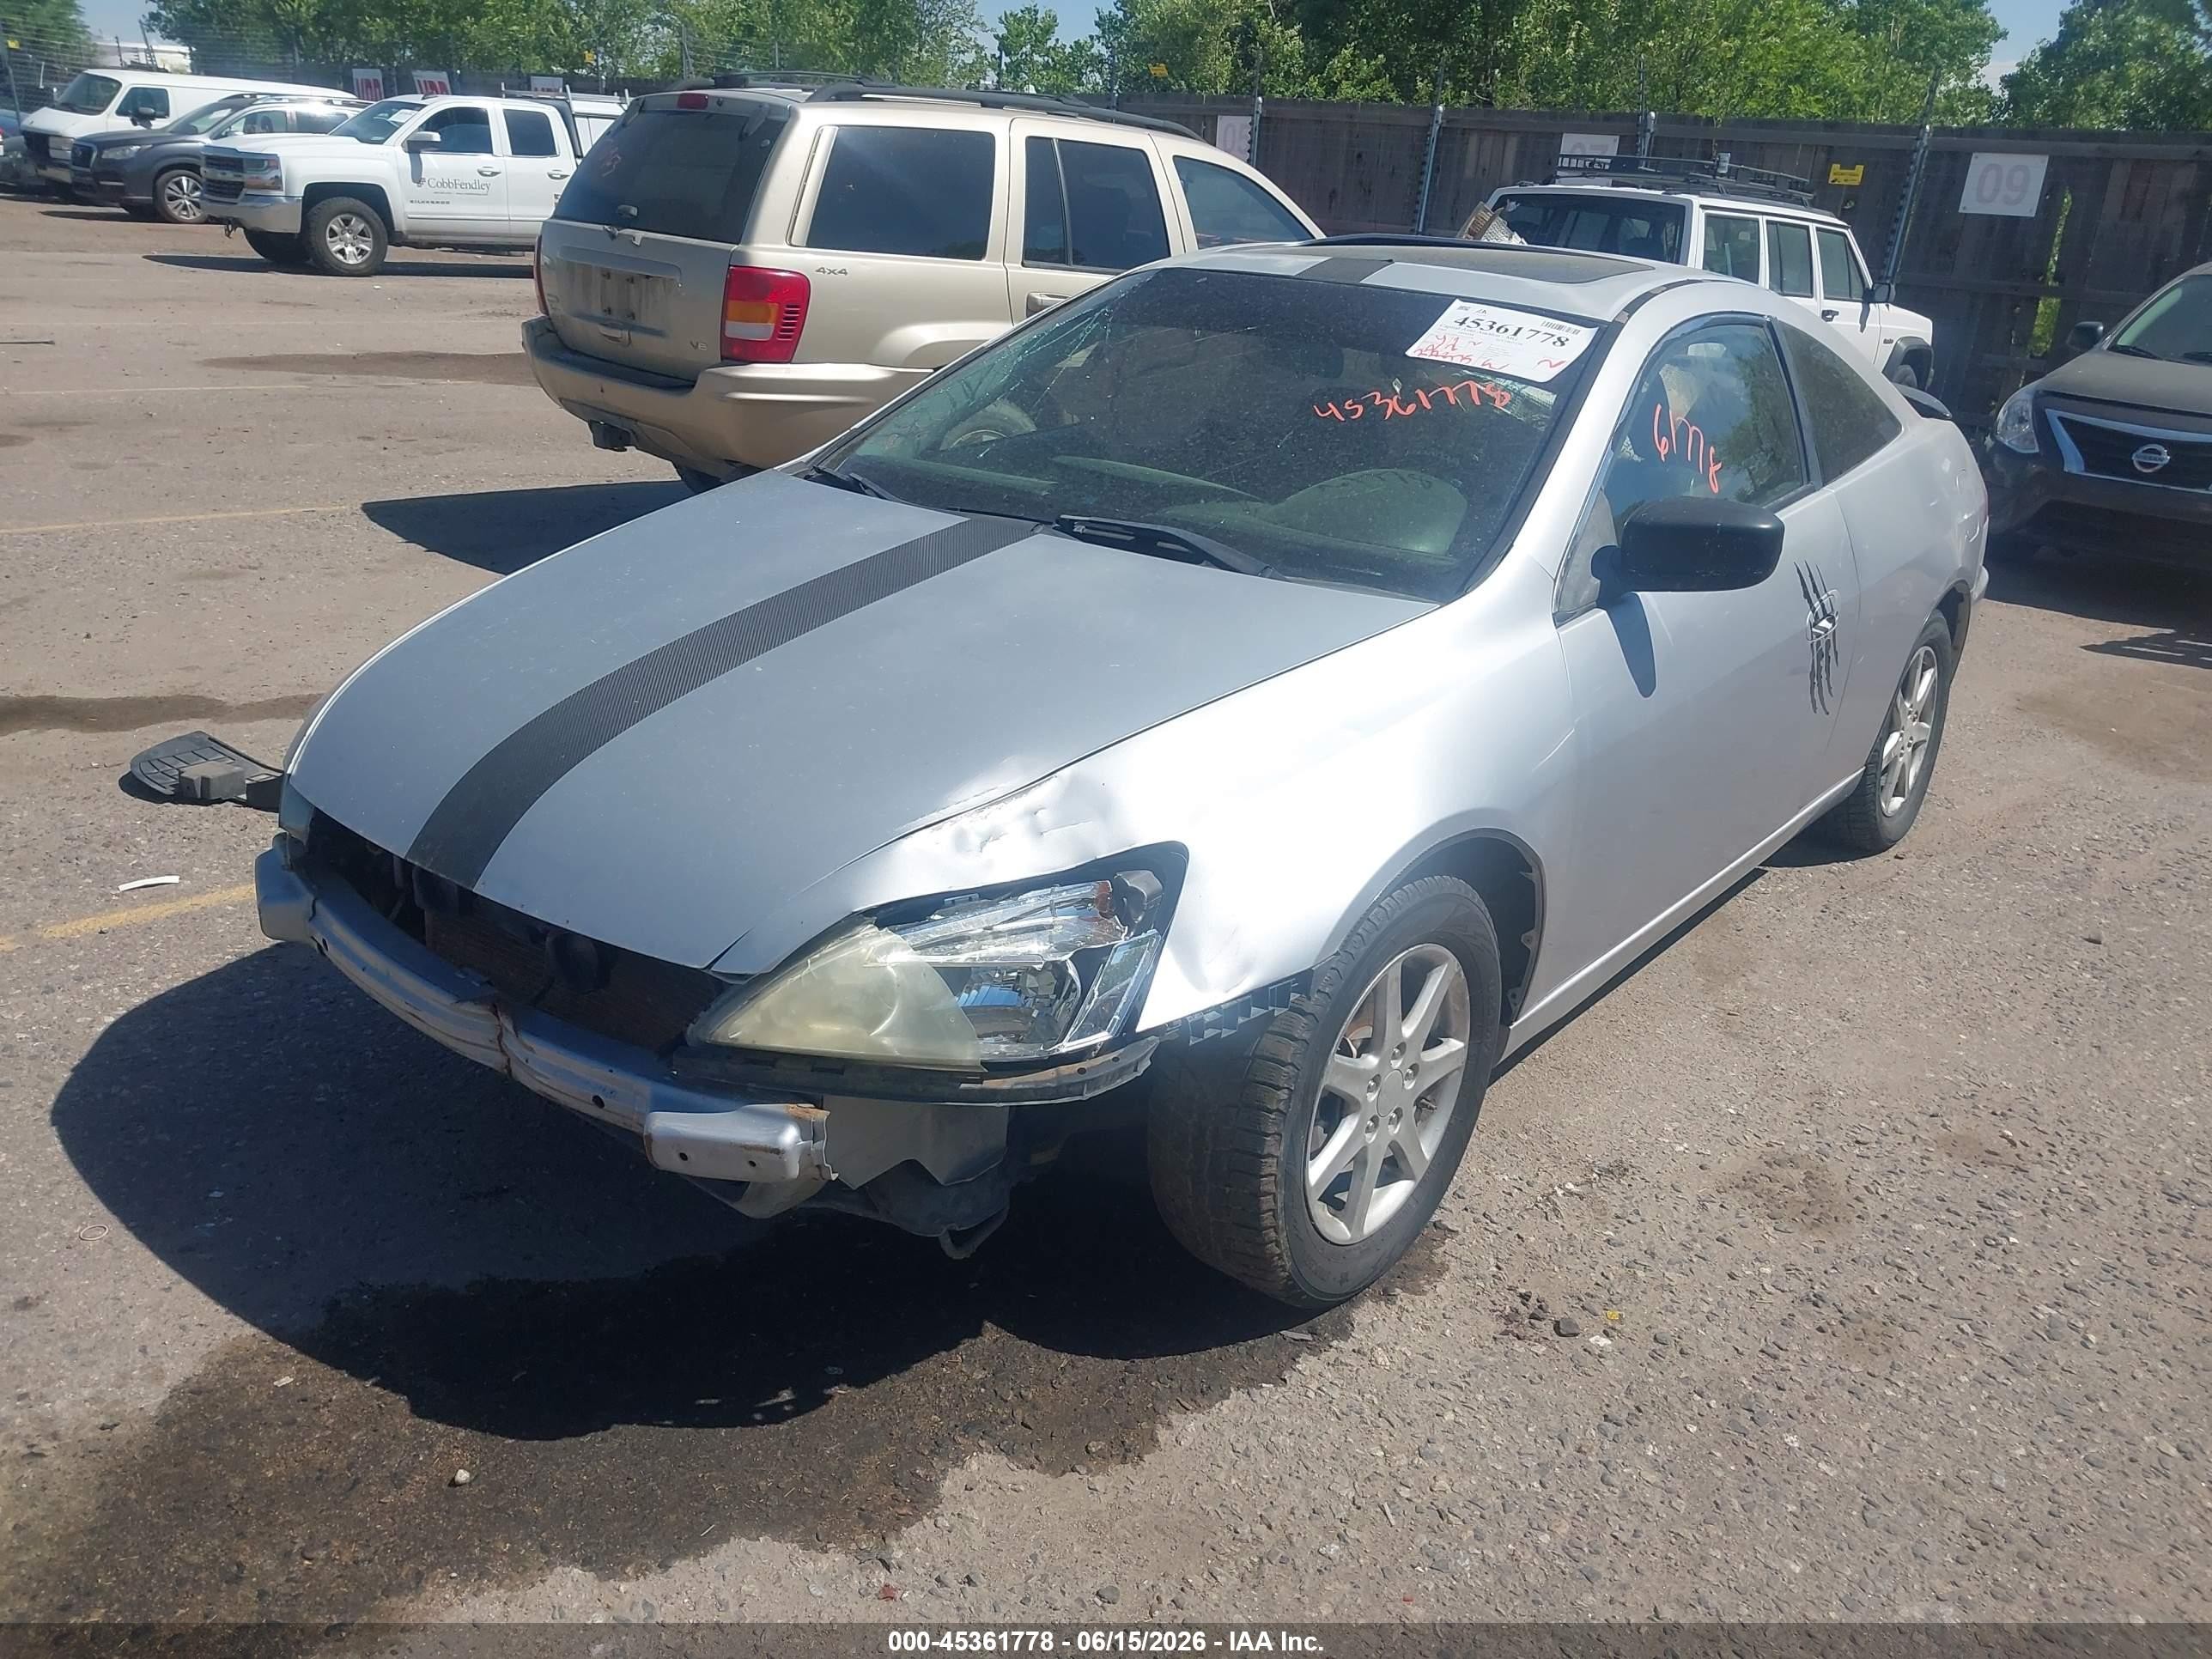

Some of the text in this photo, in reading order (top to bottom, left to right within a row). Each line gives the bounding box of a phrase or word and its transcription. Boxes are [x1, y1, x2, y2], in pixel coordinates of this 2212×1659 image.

[428, 178, 490, 192] CobbFendley
[1977, 163, 2030, 206] 09
[1454, 316, 1570, 348] 45361778
[1313, 380, 1511, 422] 45361778
